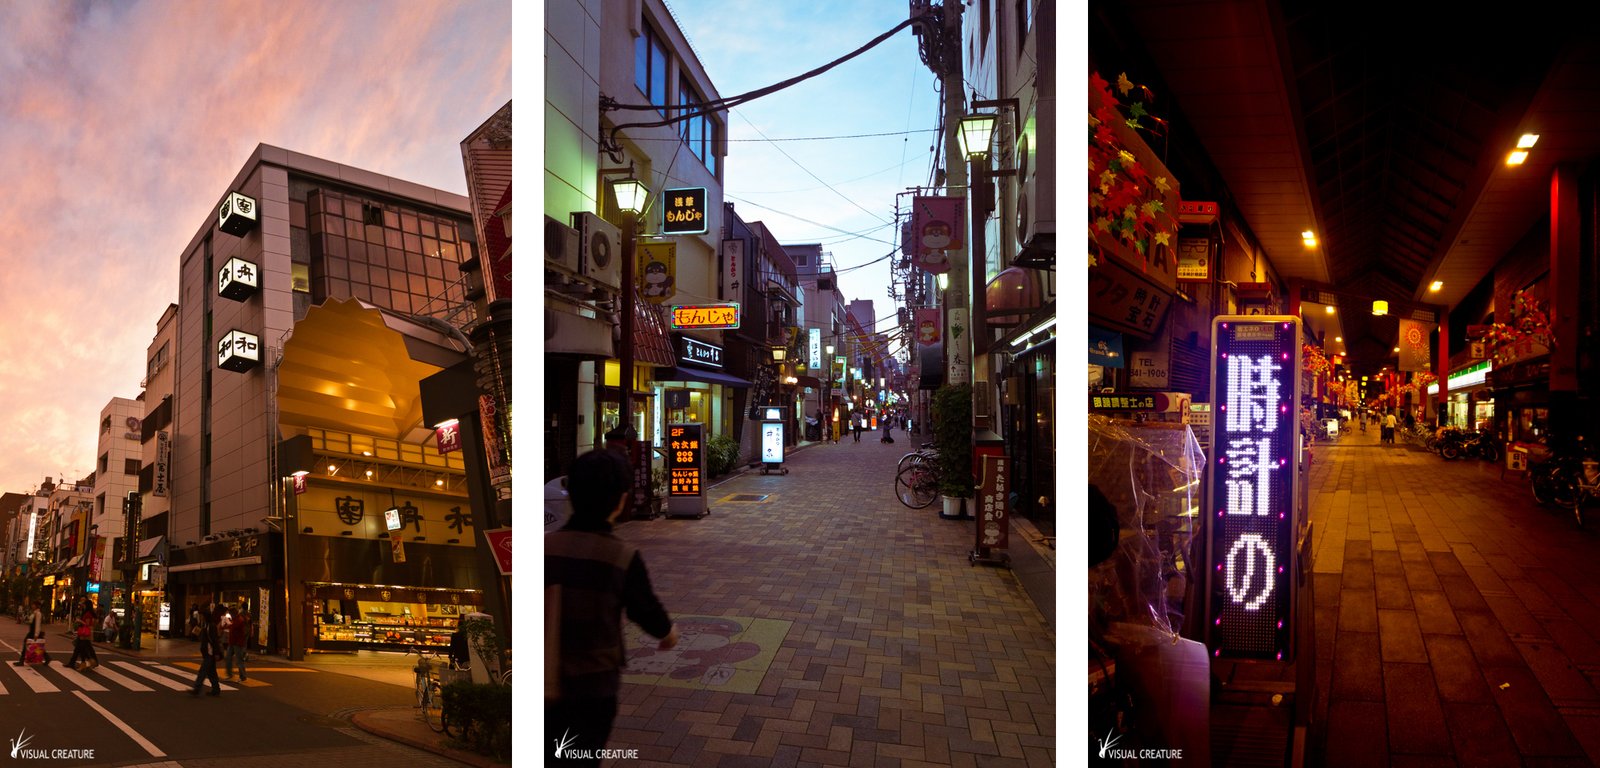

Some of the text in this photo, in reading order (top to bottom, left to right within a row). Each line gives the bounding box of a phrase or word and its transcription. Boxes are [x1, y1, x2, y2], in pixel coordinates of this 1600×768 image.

[674, 196, 694, 207] 浅草
[666, 208, 702, 222] もんじゃ
[676, 310, 734, 324] もんじゃ
[1138, 358, 1155, 367] TEL
[440, 427, 457, 446] 新
[671, 428, 685, 437] 2F
[1225, 354, 1282, 611] 時計の
